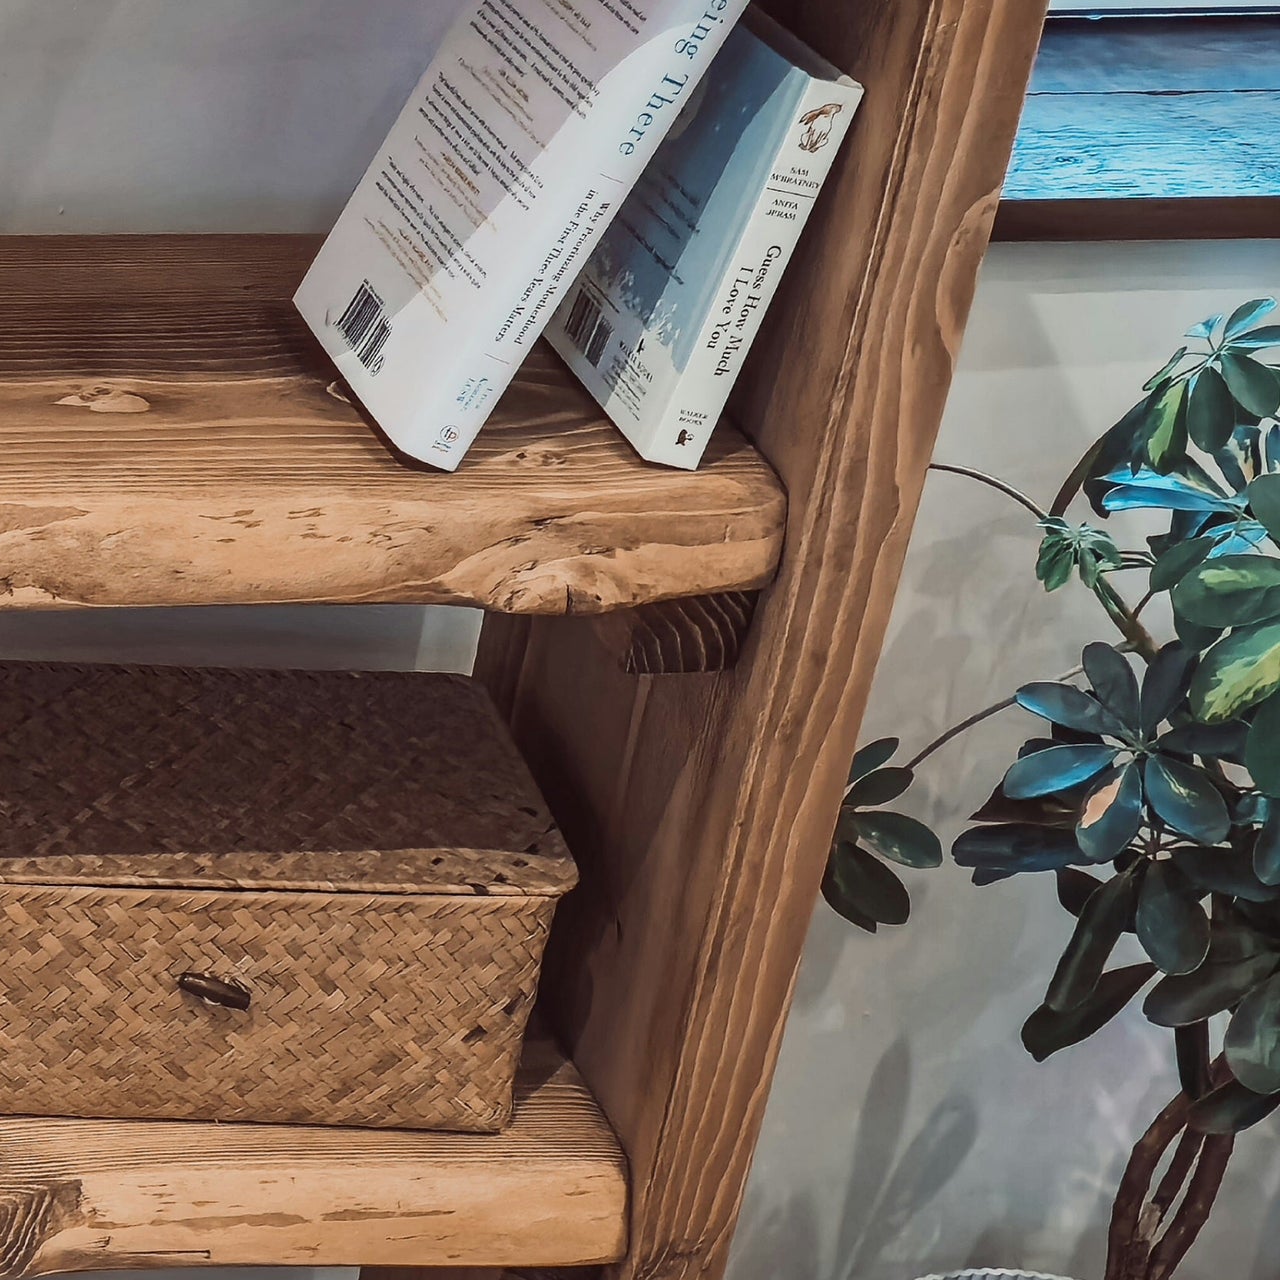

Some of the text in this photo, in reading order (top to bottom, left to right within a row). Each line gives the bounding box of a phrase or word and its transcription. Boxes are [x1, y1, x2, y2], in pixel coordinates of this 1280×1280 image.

[618, 72, 689, 156] There
[589, 201, 611, 225] Why
[771, 198, 799, 211] ANITA
[495, 189, 599, 343] in the First Three Years Matters
[551, 226, 594, 283] Prioritizing
[513, 284, 558, 345] Motherhood
[713, 245, 782, 376] Guess How Much
[722, 278, 749, 315] Love
[706, 320, 732, 350] You
